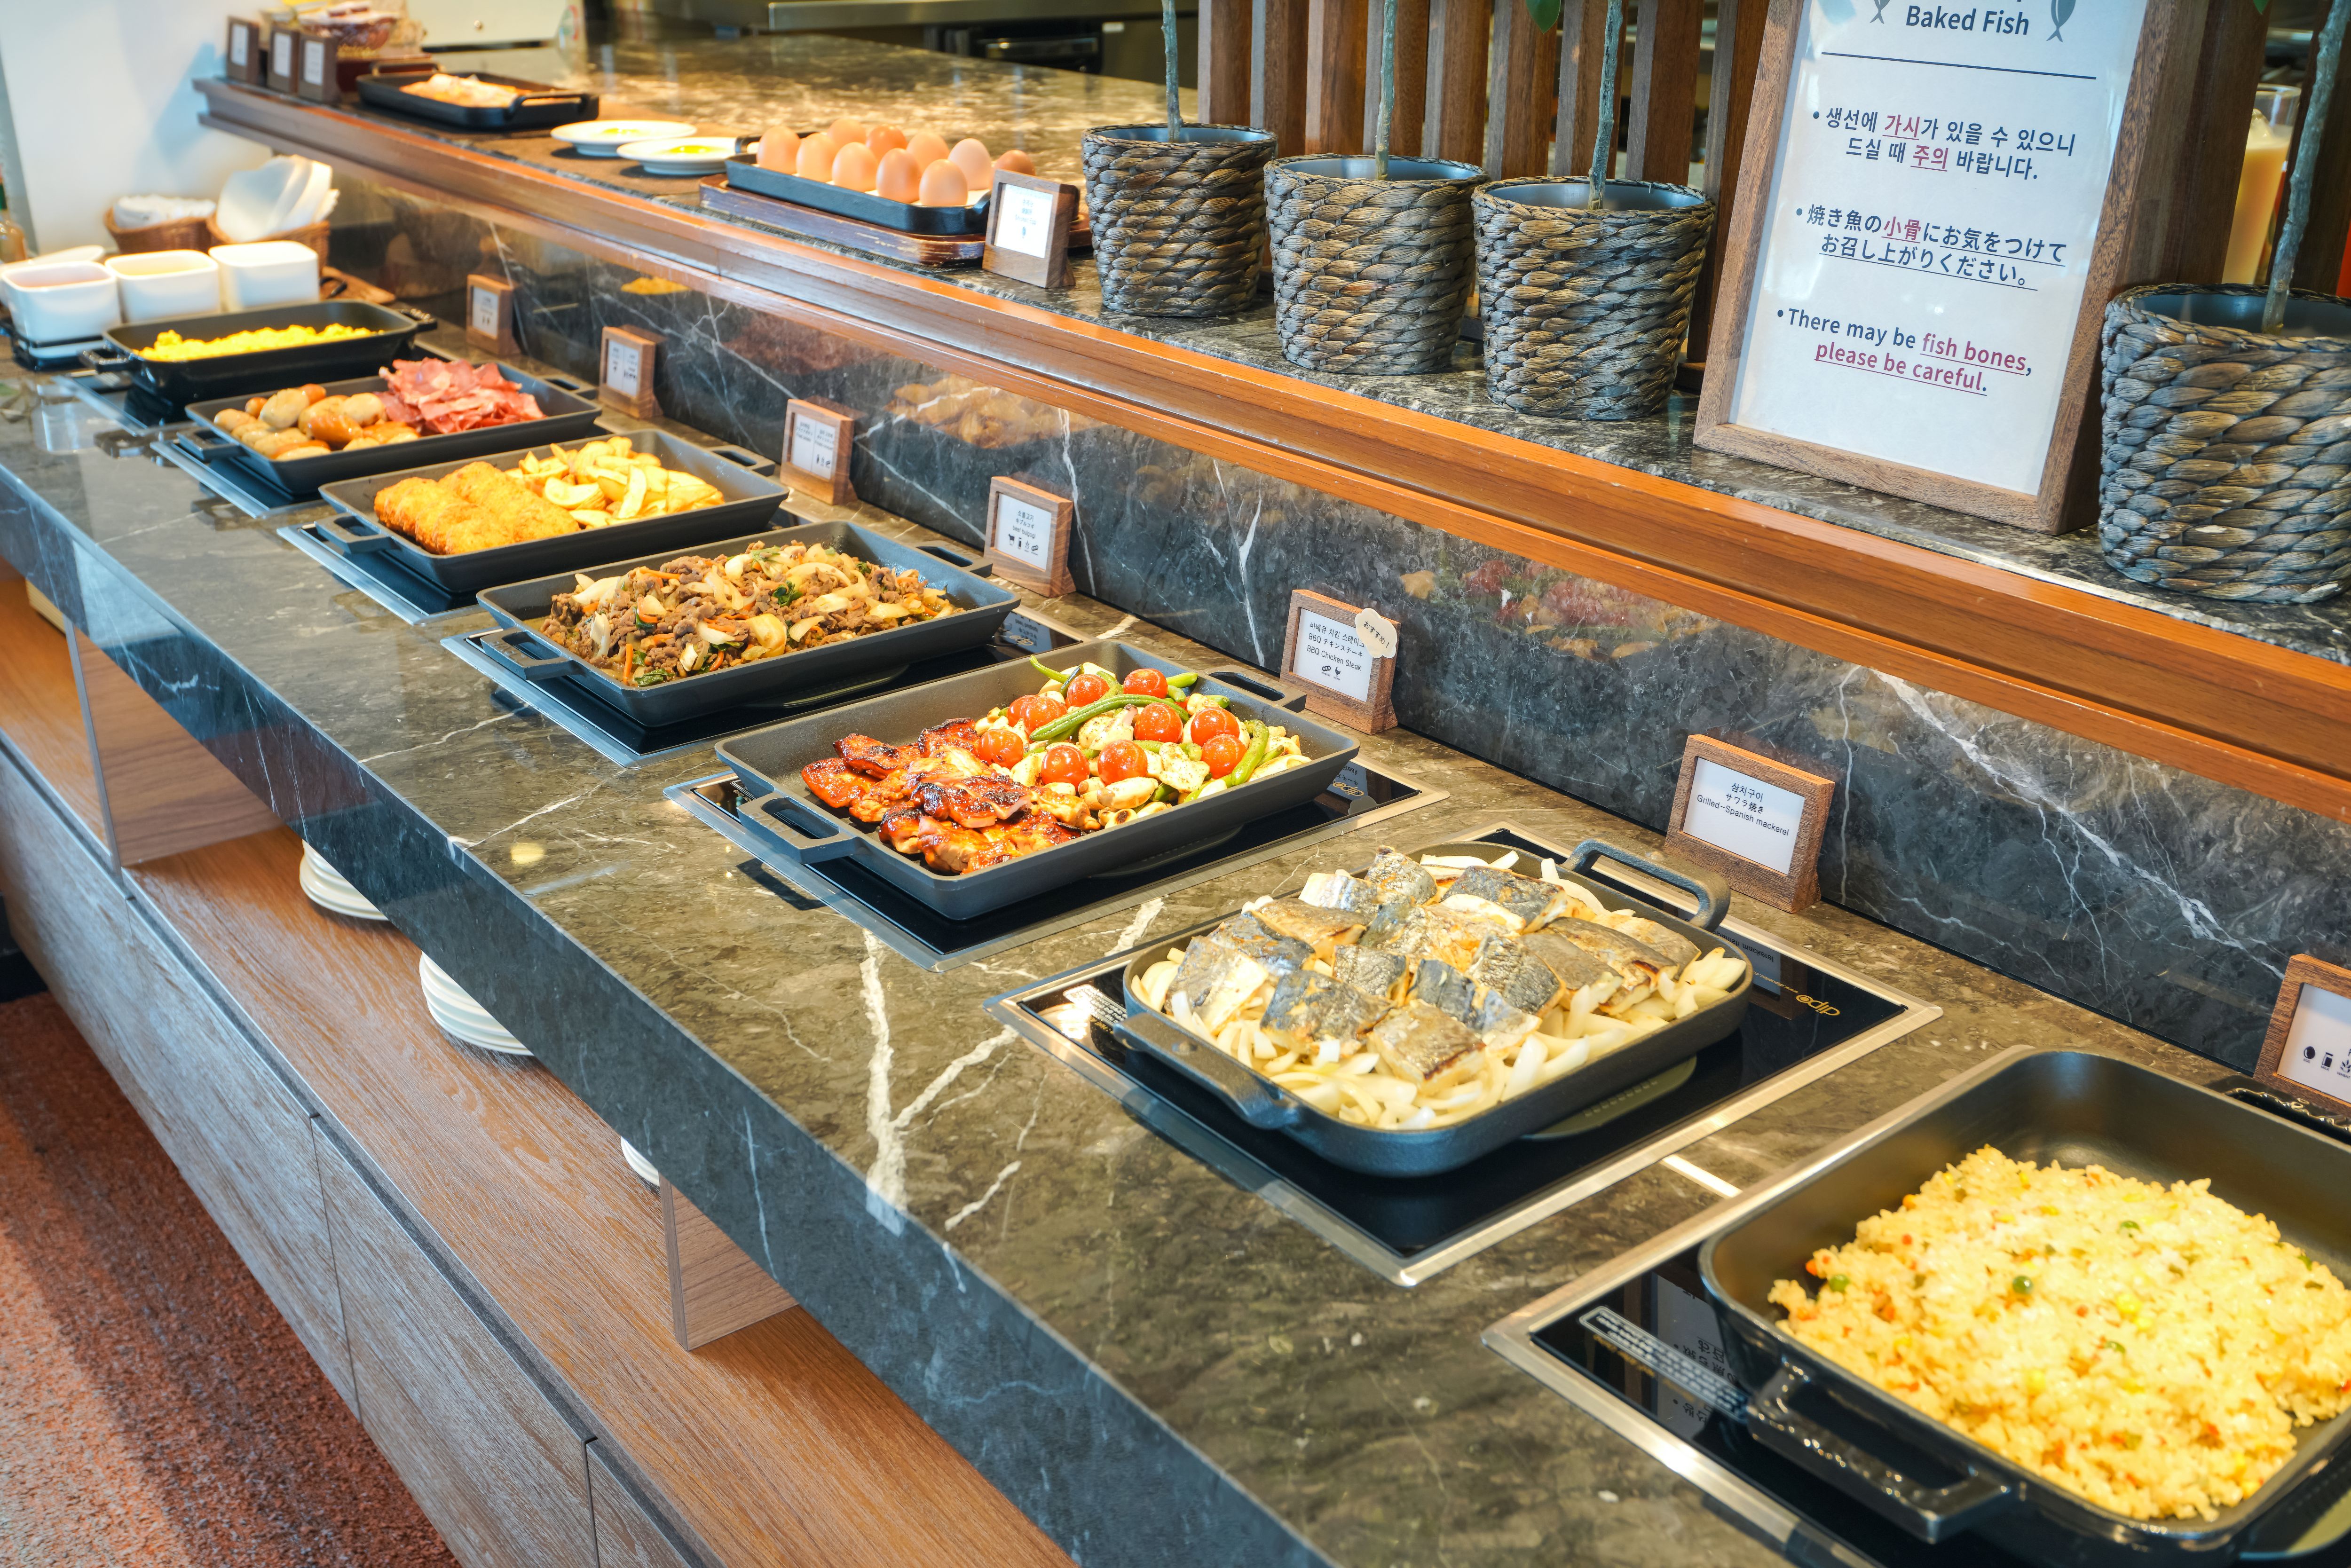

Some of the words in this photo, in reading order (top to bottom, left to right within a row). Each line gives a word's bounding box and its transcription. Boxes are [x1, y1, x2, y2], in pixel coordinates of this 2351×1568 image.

[1906, 5, 1976, 31] Baked
[1982, 10, 2029, 35] Fish
[1825, 106, 1877, 134] 생선에
[1883, 114, 1938, 141] 가시가
[1946, 122, 1982, 145] 있을
[1990, 126, 2008, 145] 수
[2017, 129, 2076, 157] 있으니
[1845, 137, 1880, 161] 드실
[1888, 142, 1905, 164] 때
[1912, 145, 1948, 170] 주의
[1956, 150, 2038, 181] 바랍니다.
[1807, 203, 2067, 263] 焼き魚の小骨にお気をつけて
[1789, 308, 1840, 334] There
[1846, 323, 1887, 347] may
[1893, 327, 1916, 349] be
[1921, 332, 1957, 357] fish
[1964, 341, 2032, 376] bones,
[1816, 339, 1878, 369] please
[1884, 353, 1906, 375] be
[1912, 360, 1988, 393] careful.
[1022, 529, 1036, 539] bulgogi
[1310, 622, 1327, 634] 바베큐
[1329, 628, 1340, 639] 치킨
[1307, 645, 1319, 655] BBQ
[1321, 650, 1343, 664] Chicken
[1345, 659, 1361, 671] Steak
[1309, 633, 1321, 643] BBQ
[1323, 638, 1363, 658] チキンステーキ
[1726, 793, 1764, 813] サワラ焼き
[1731, 783, 1763, 802] 삼치구이
[1756, 818, 1789, 836] mackerel
